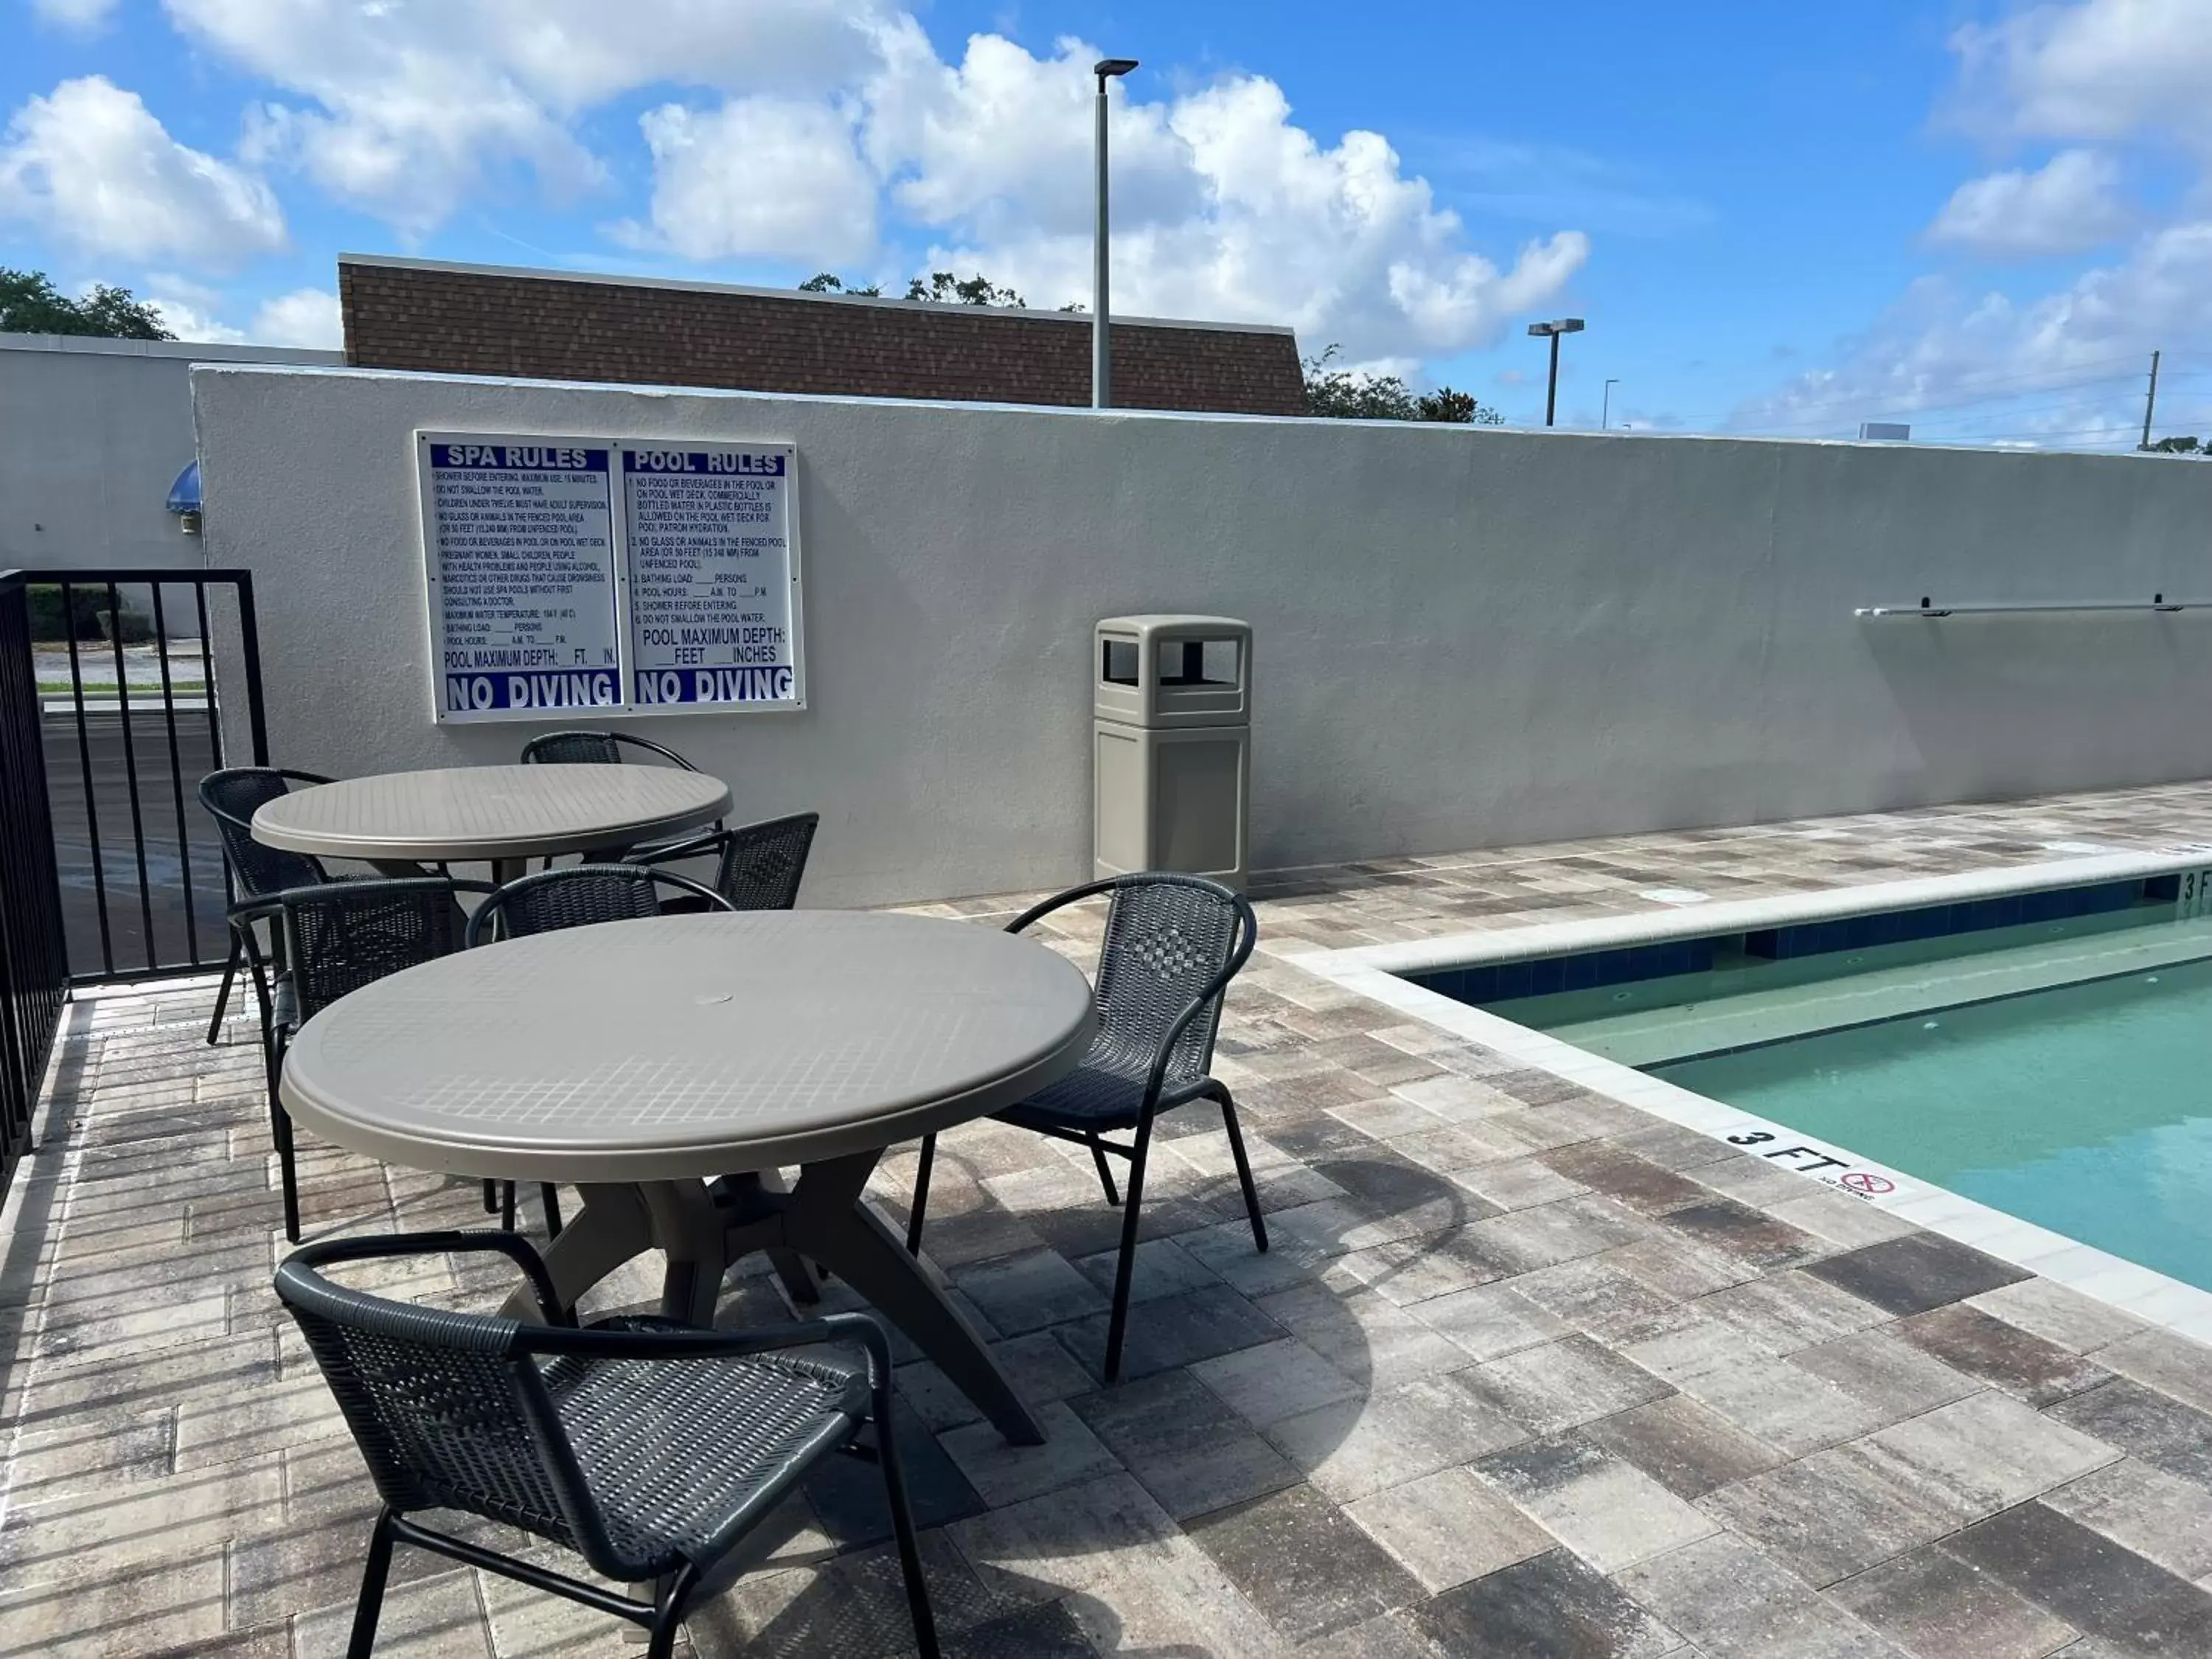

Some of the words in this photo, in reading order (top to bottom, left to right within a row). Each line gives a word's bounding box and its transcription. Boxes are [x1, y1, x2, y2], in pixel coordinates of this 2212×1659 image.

[448, 446, 498, 466] SPA
[506, 447, 587, 468] RULES
[635, 451, 695, 472] POOL
[708, 453, 778, 473] RULES
[637, 478, 647, 487] NO
[648, 479, 667, 487] FOOD
[681, 479, 722, 489] BEVERAGES
[724, 480, 731, 489] IN
[732, 480, 745, 489] THE
[745, 480, 765, 490] POOL
[447, 484, 459, 494] NOT
[461, 485, 492, 495] SWALLOW
[505, 486, 521, 495] POOL
[649, 490, 667, 499] POOL
[669, 490, 684, 499] WET
[708, 491, 760, 501] COMMERCIALLY
[438, 498, 468, 508] CHILDREN
[470, 499, 490, 508] UNDER
[637, 501, 670, 509] BOTTLED
[671, 501, 695, 510] WATER
[705, 501, 734, 510] PLASTIC
[734, 501, 764, 511] BOTTLES
[449, 512, 469, 521] GLASS
[481, 513, 507, 521] ANIMALS
[515, 513, 526, 522] THE
[639, 512, 672, 521] ALLOWED
[685, 512, 699, 521] THE
[700, 512, 719, 522] POOL
[720, 512, 735, 522] WET
[639, 523, 658, 532] POOL
[659, 523, 688, 532] PATRON
[451, 538, 467, 546] FOOD
[479, 538, 515, 546] BEVERAGES
[523, 538, 539, 546] POOL
[560, 538, 575, 546] POOL
[639, 536, 650, 546] NO
[651, 536, 675, 546] GLASS
[687, 537, 718, 546] ANIMALS
[727, 538, 740, 546] THE
[741, 538, 768, 547] FENCED
[553, 551, 575, 559] PEOPLE
[641, 548, 659, 557] AREA
[684, 548, 701, 557] FEET
[482, 563, 515, 571] PROBLEMS
[529, 563, 552, 571] PEOPLE
[640, 560, 678, 568] UNFENCED
[488, 574, 509, 582] OTHER
[641, 574, 672, 583] BATHING
[715, 573, 747, 582] PERSONS
[557, 585, 573, 593] FIRST
[642, 588, 661, 597] POOL
[728, 587, 737, 596] TO
[642, 601, 673, 611] SHOWER
[675, 601, 702, 610] BEFORE
[643, 615, 653, 624] DO
[655, 614, 669, 624] NOT
[671, 613, 706, 623] SWALLOW
[707, 613, 720, 623] THE
[721, 613, 740, 623] POOL
[526, 636, 535, 644] TO
[644, 628, 678, 646] POOL
[681, 627, 740, 645] MAXIMUM
[742, 627, 785, 644] DEPTH:
[445, 651, 473, 669] POOL
[474, 650, 523, 668] MAXIMUM
[524, 649, 558, 667] DEPTH:
[574, 648, 587, 665] FT.
[604, 647, 615, 664] IN.
[675, 647, 706, 664] FEET
[733, 645, 776, 663] INCHES
[638, 670, 681, 704] NO
[695, 668, 793, 703] DIVING
[448, 675, 493, 711] NO
[508, 672, 613, 709] DIVING
[2185, 872, 2195, 900] 3
[1727, 1132, 1776, 1145] 3
[1762, 1147, 1851, 1172] FT
